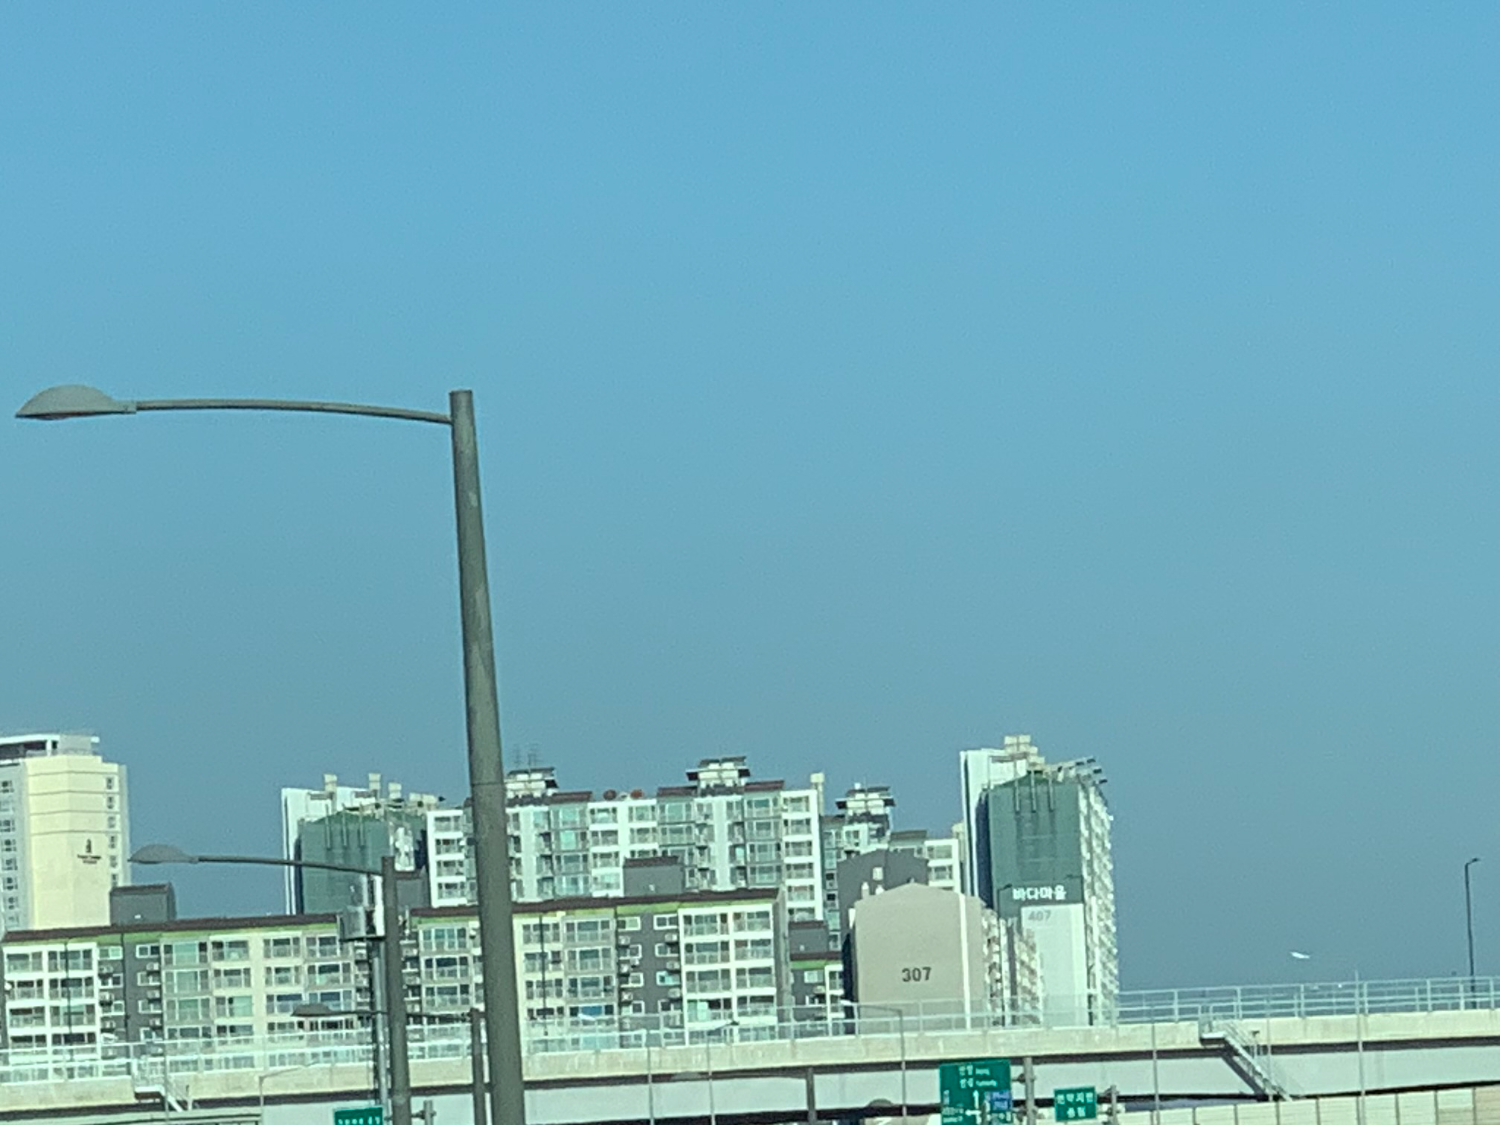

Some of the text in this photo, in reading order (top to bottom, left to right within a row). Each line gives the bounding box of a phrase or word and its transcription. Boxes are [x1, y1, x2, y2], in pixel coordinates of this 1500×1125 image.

[1012, 884, 1067, 901] 바다마을
[1028, 909, 1052, 922] 407
[902, 966, 932, 982] 307
